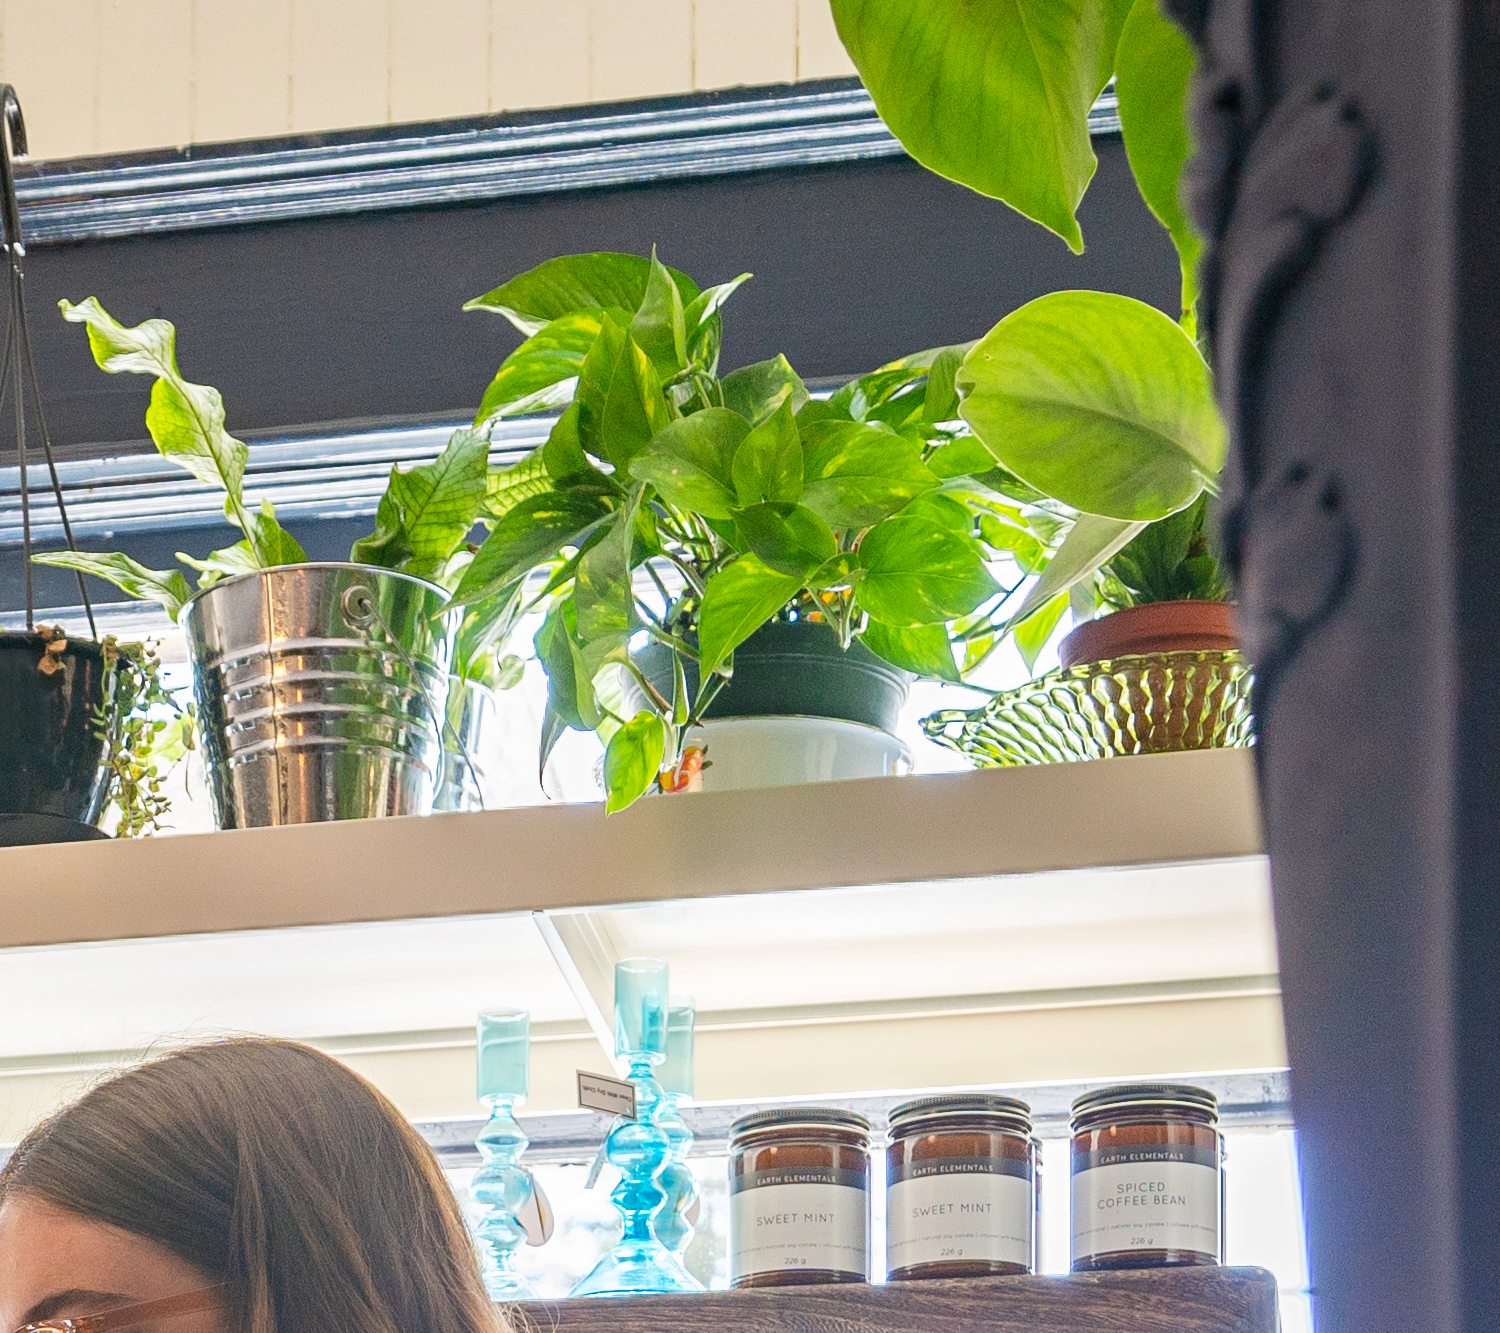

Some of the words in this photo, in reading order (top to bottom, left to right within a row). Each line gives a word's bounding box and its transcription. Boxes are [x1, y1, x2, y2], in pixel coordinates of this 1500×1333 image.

[1101, 1154, 1126, 1164] EARTH
[1130, 1152, 1184, 1160] ELEMENTALS
[913, 1167, 937, 1177] EARTH
[940, 1164, 994, 1173] ELEMENTALS
[757, 1176, 781, 1185] EARTH
[784, 1174, 836, 1183] ELEMENTALS
[1117, 1182, 1165, 1193] SPICED
[1097, 1195, 1148, 1209] COFFEE
[1153, 1194, 1186, 1205] BEAN
[912, 1203, 954, 1218] SWEET
[960, 1203, 992, 1213] MINT
[756, 1213, 798, 1226] SWEET
[804, 1213, 835, 1223] MINT
[940, 1248, 955, 1256] 226
